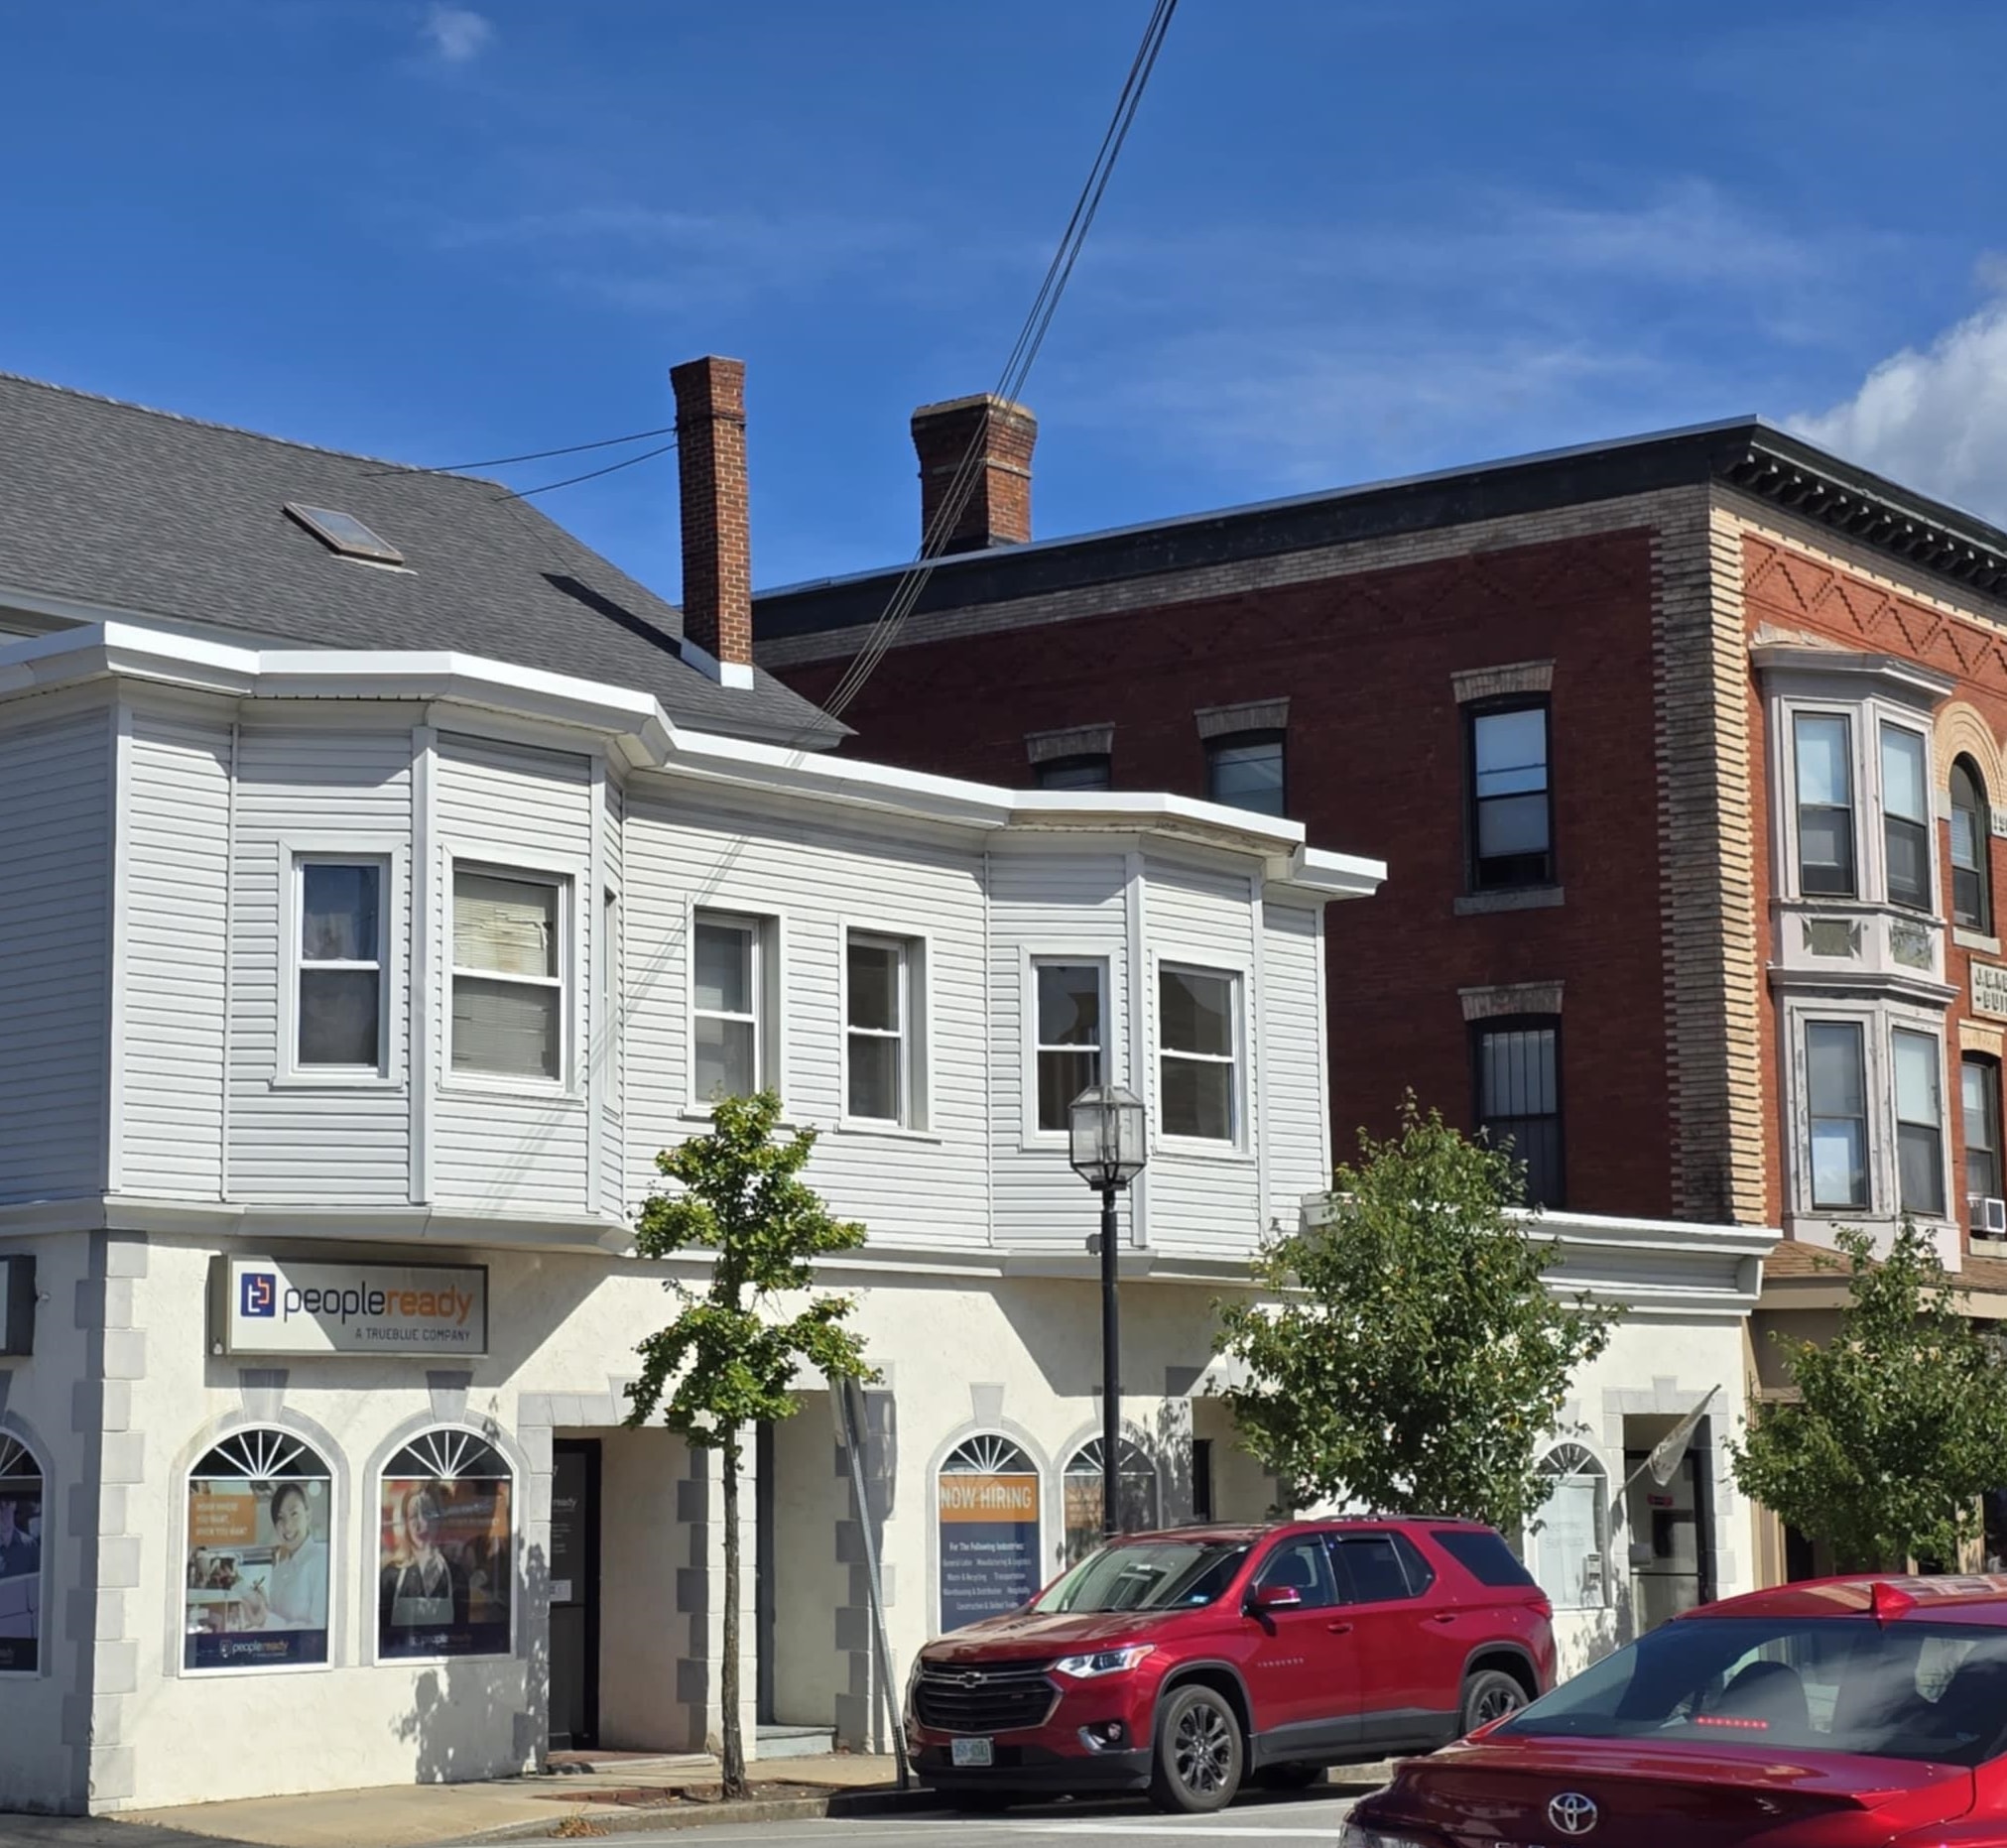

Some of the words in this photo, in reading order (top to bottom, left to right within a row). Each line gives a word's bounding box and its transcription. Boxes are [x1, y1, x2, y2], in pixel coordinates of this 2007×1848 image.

[284, 1281, 473, 1325] peopleready
[355, 1328, 362, 1339] A
[366, 1328, 420, 1341] TRUEBLUE
[422, 1329, 471, 1342] COMPANY
[941, 1485, 976, 1509] NOW
[980, 1486, 1032, 1509] HIRING
[948, 1541, 958, 1551] For
[958, 1541, 969, 1550] The
[970, 1541, 996, 1552] Following
